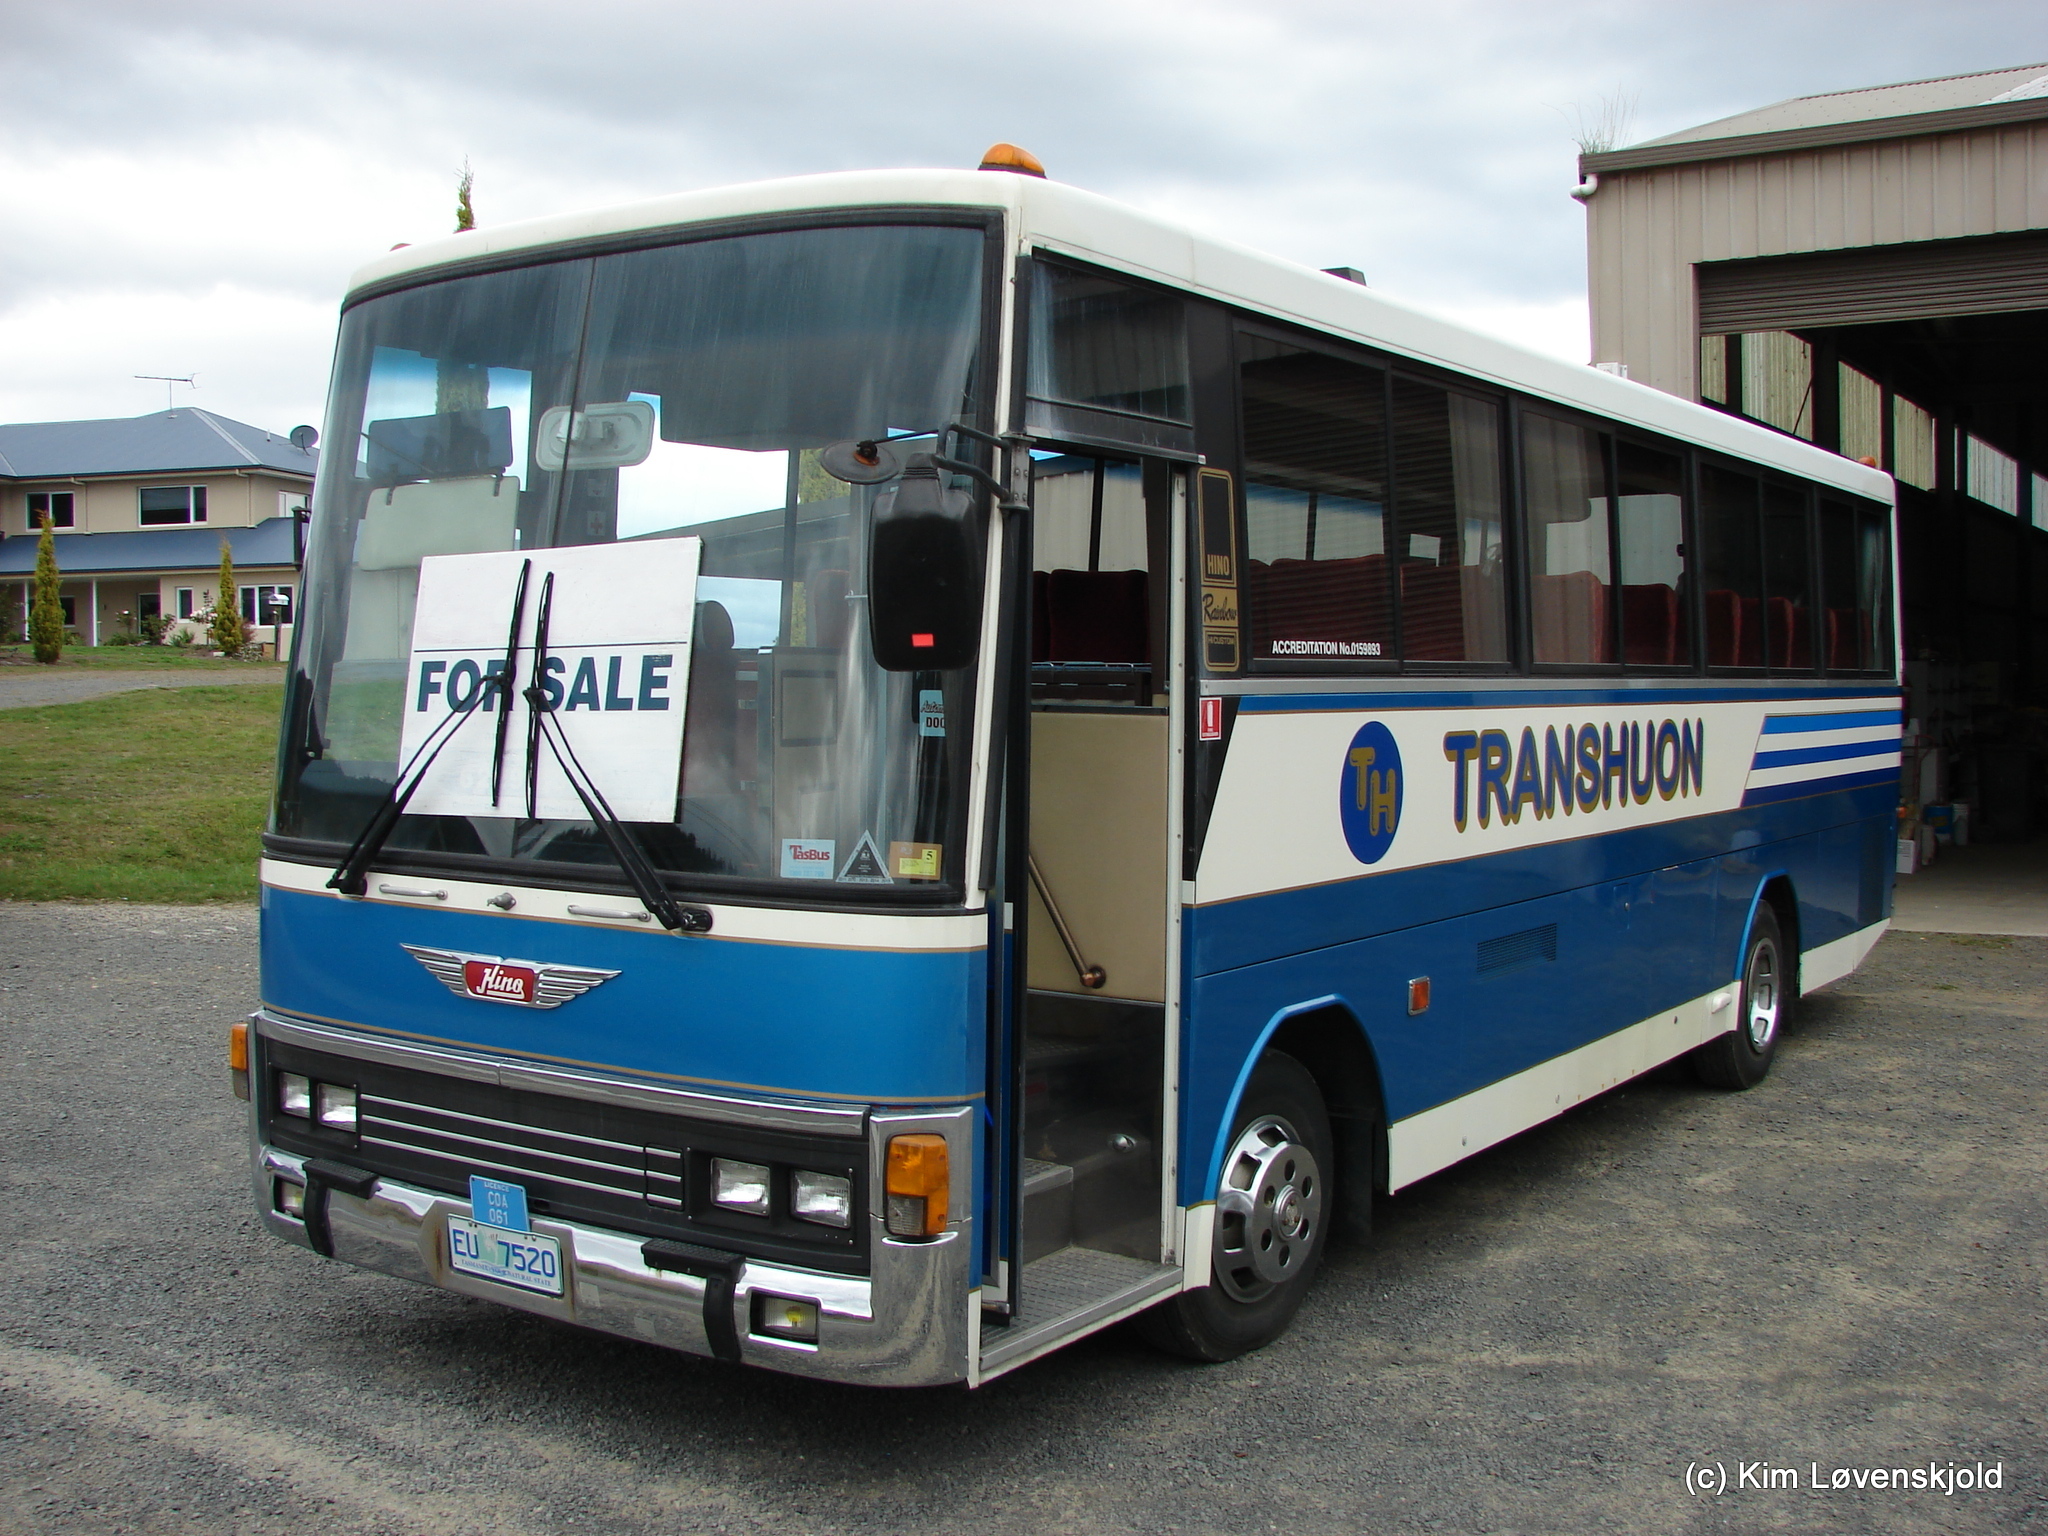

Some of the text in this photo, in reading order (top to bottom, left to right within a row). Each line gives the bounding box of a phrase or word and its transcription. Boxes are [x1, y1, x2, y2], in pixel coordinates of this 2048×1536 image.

[1207, 554, 1229, 576] HINO
[1202, 593, 1237, 622] Rainbow
[1272, 640, 1381, 656] ACCREDITATION No.0159893
[543, 655, 673, 712] SALE
[1443, 717, 1703, 834] TRANSHUON
[789, 845, 831, 860] TasBus
[926, 851, 933, 861] 5
[476, 965, 525, 999] Hino
[484, 1182, 510, 1193] LICENCE
[489, 1208, 508, 1225] 061
[452, 1228, 555, 1277] EU 7520
